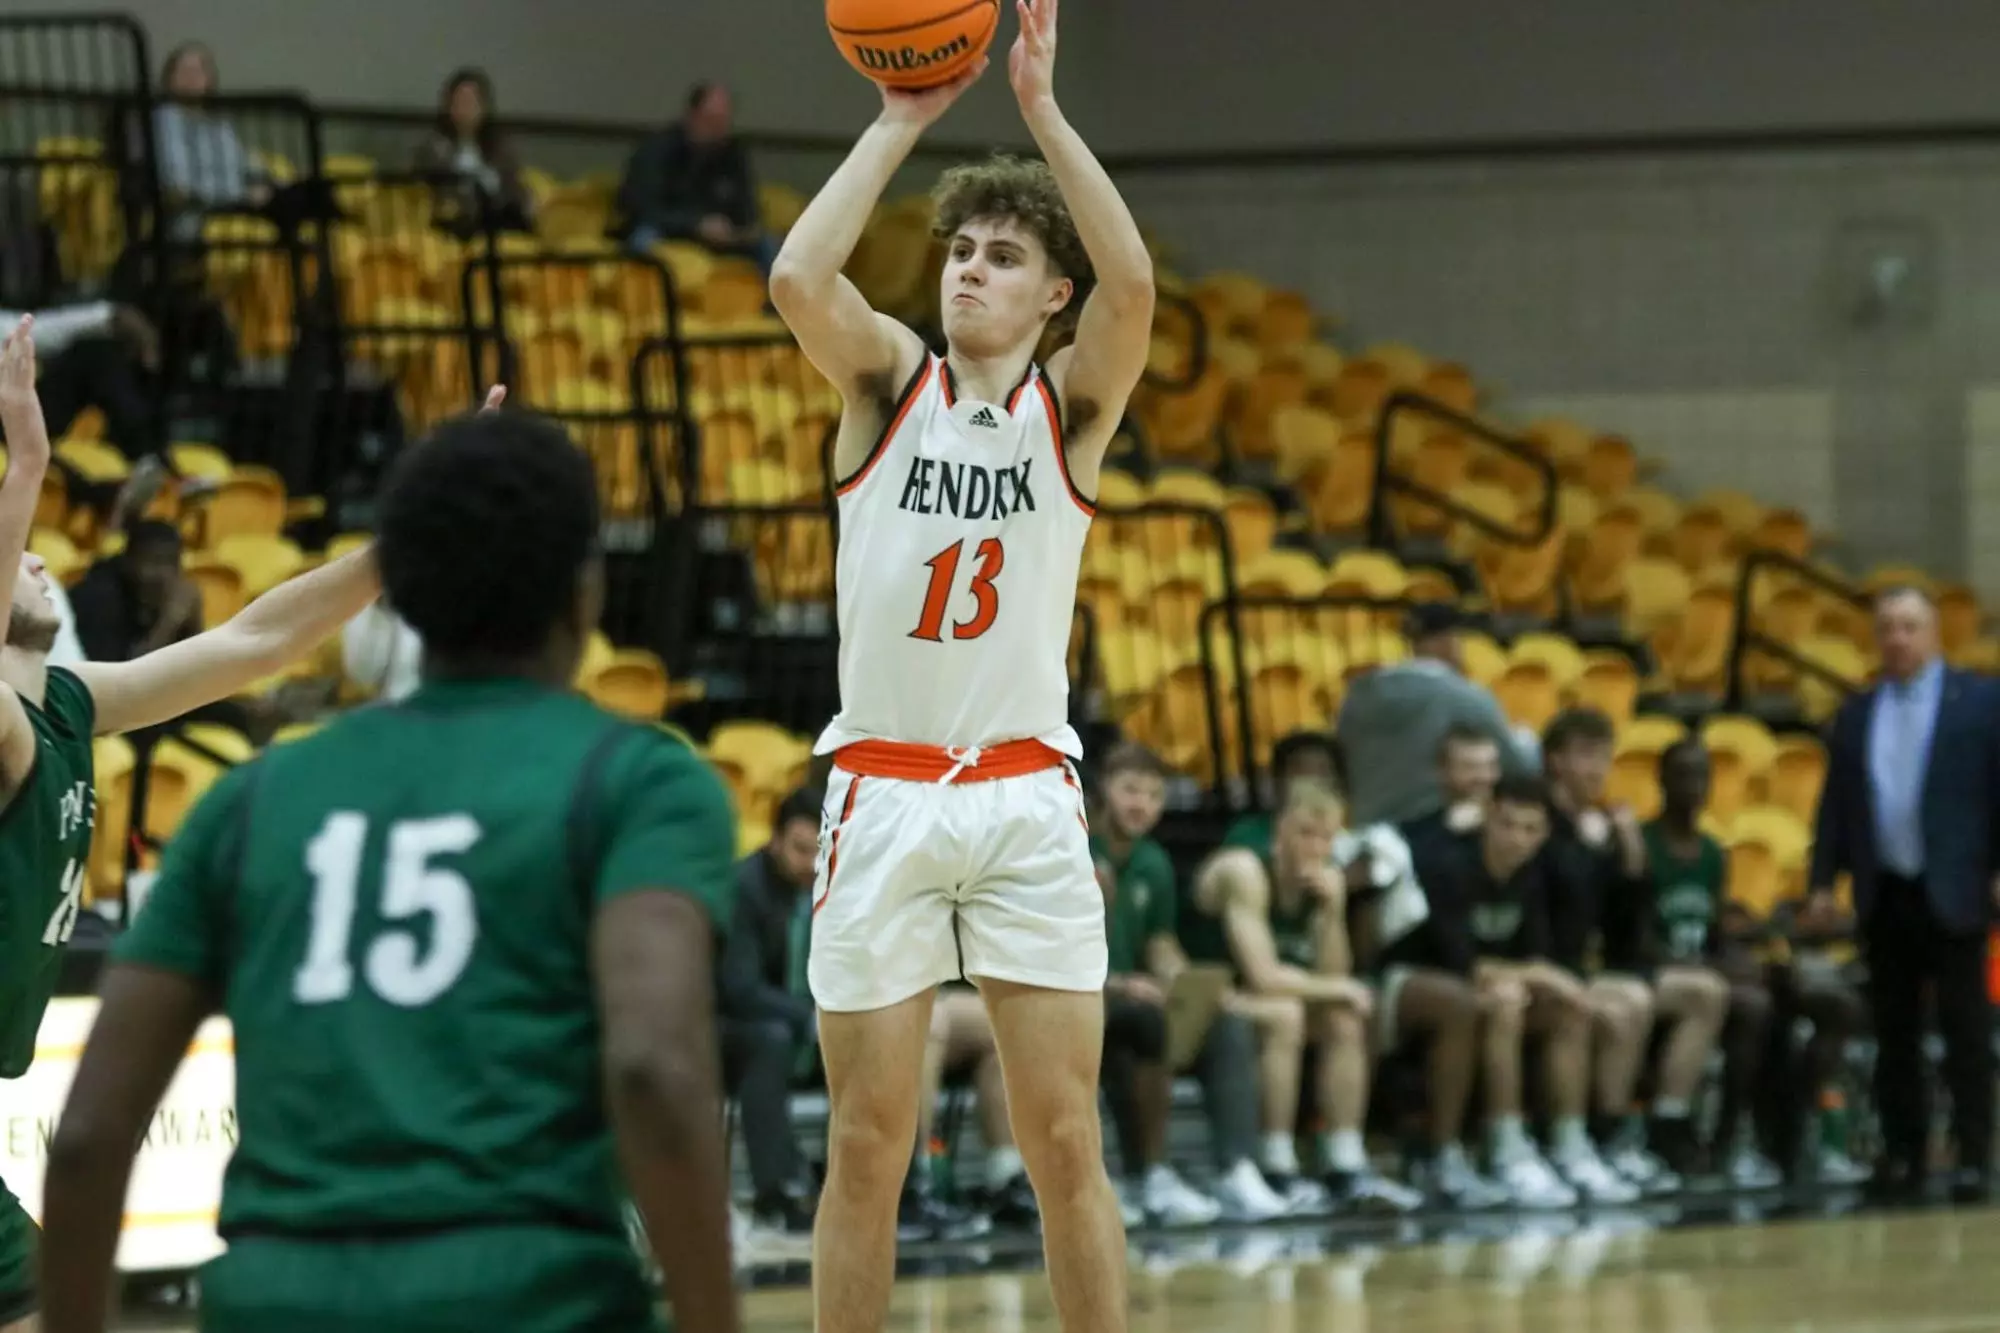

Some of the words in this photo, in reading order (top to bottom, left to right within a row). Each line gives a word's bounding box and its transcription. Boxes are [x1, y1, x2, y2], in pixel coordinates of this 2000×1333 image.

[853, 32, 969, 72] Wilson
[906, 537, 1005, 643] 13
[293, 808, 484, 1007] 15
